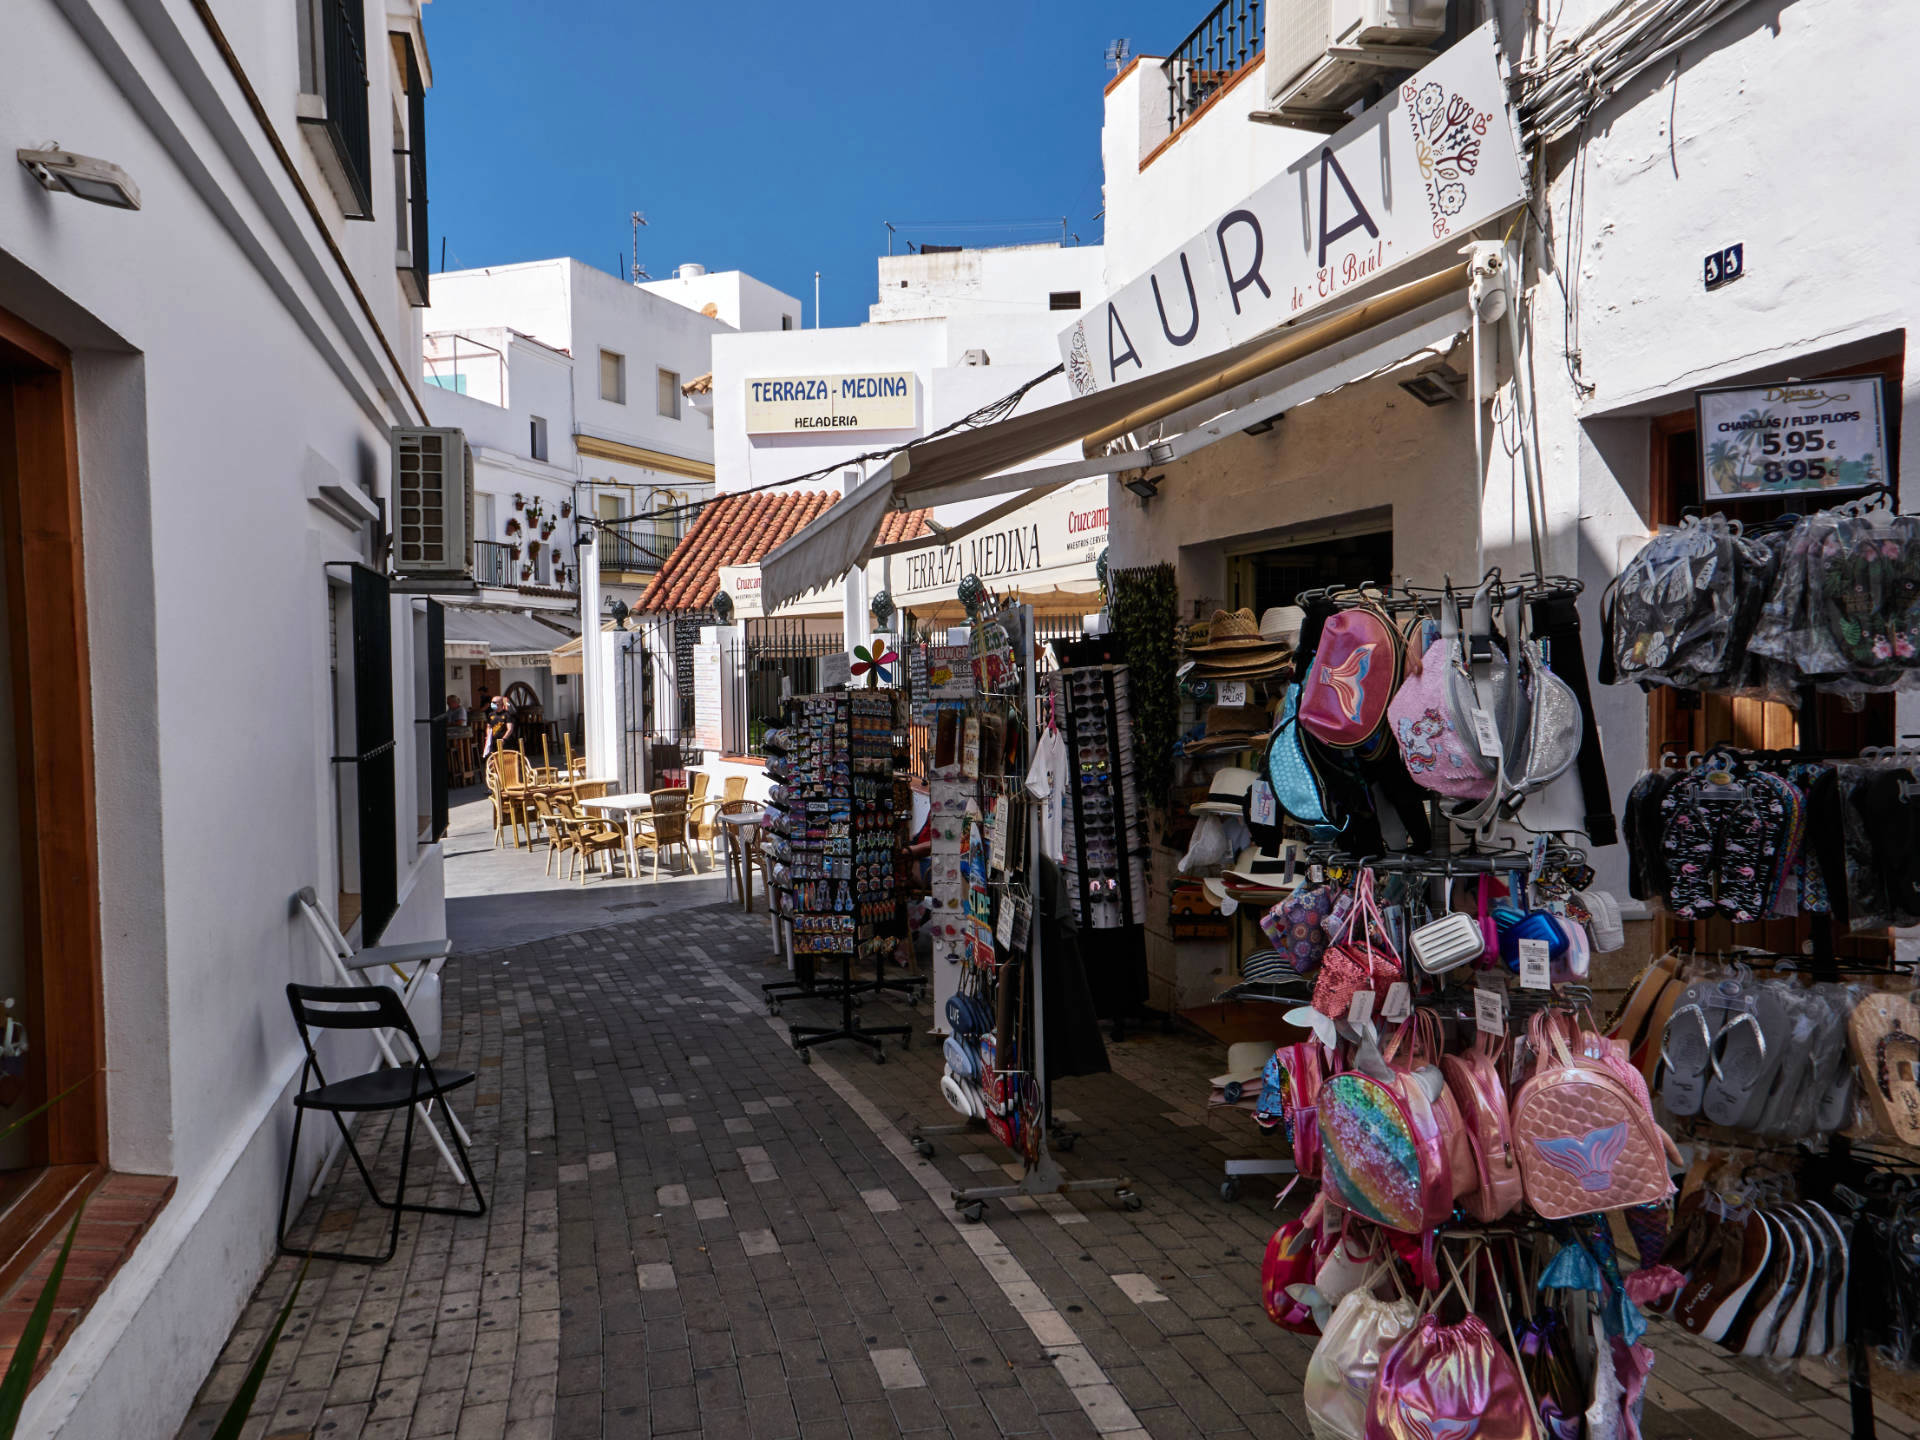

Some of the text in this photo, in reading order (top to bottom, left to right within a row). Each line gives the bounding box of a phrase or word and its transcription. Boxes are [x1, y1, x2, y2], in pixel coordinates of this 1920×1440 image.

[1106, 146, 1380, 383] AURA
[752, 380, 828, 403] TERRAZA
[842, 376, 907, 399] MEDINA
[794, 415, 858, 428] HELADERIA
[1791, 415, 1819, 427] FLIP
[1820, 411, 1861, 424] FLOPS
[1762, 429, 1825, 456] 5,95
[1763, 457, 1826, 484] 8,95
[906, 523, 1042, 591] TERRAZA MEDINA
